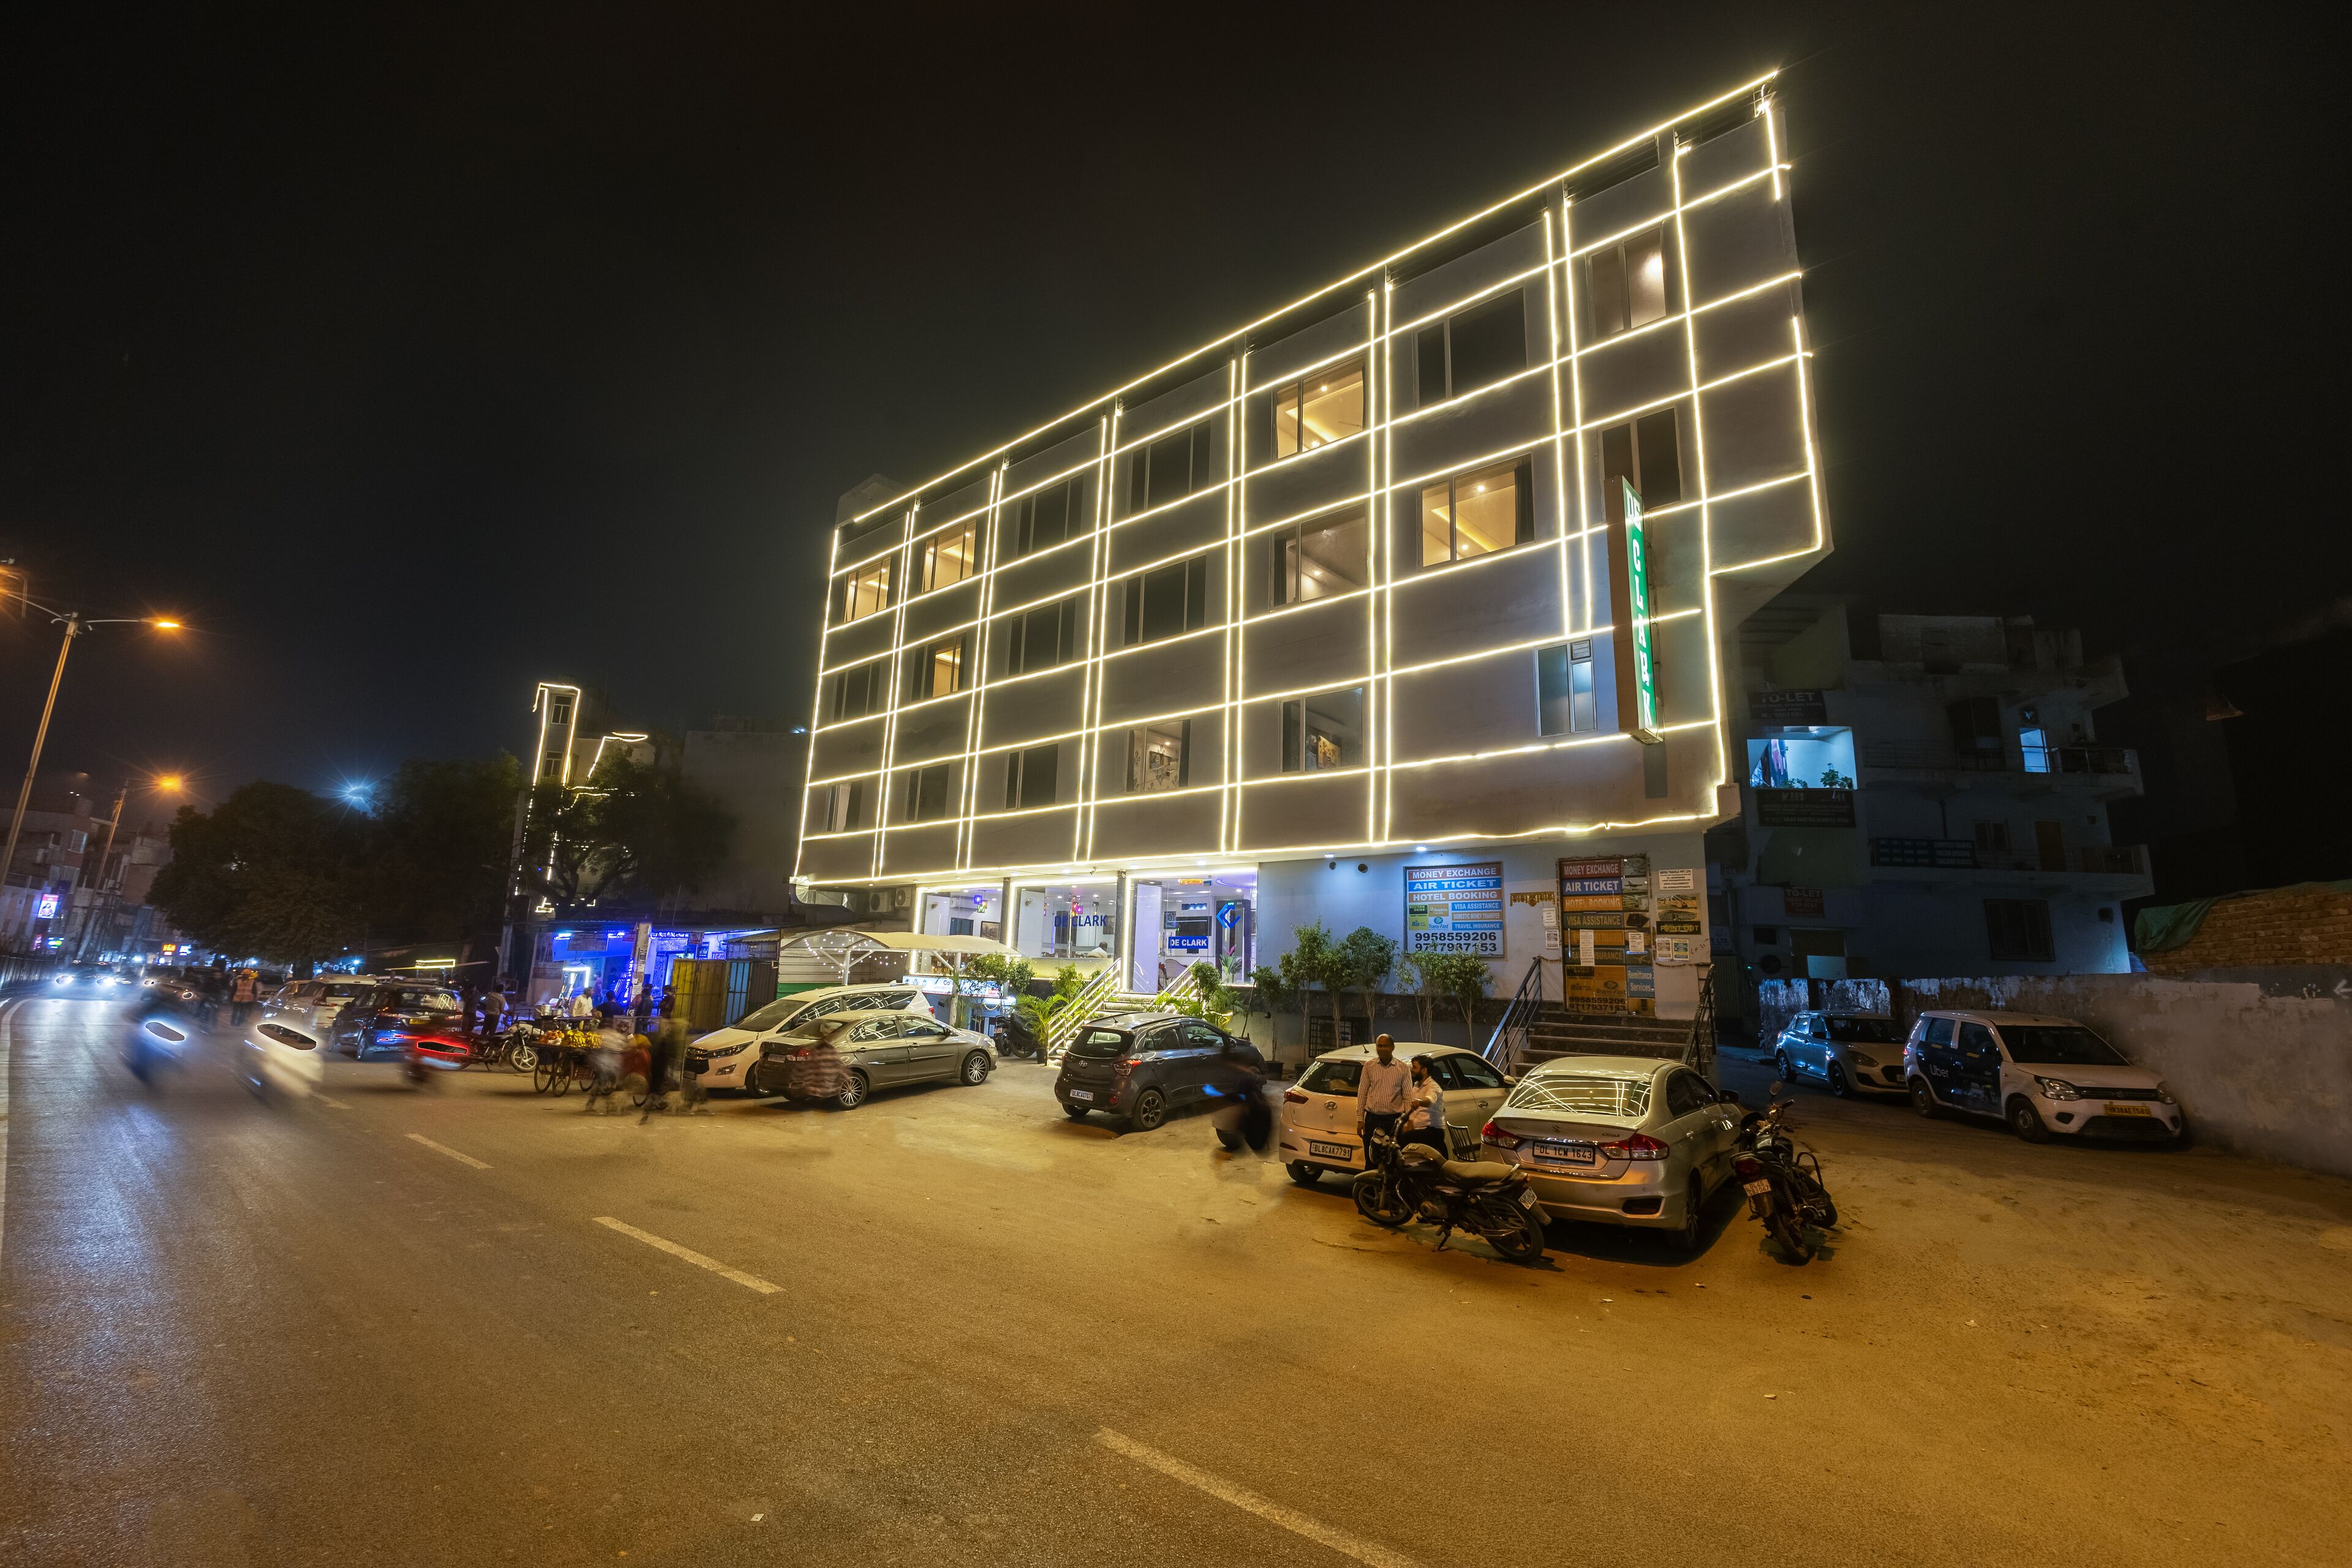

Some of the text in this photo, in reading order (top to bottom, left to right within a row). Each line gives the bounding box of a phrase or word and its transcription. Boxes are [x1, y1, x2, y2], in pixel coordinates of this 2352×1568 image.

[1626, 488, 1653, 728] DE CLARK
[1412, 868, 1496, 879] MONEY EXCHANGE
[1564, 863, 1619, 875] MONEY EXCHANGE
[1441, 880, 1496, 888] TICKET
[1565, 881, 1619, 892] AIR TICKET
[1449, 891, 1498, 900] BOOKING
[1565, 898, 1620, 909] HOTEL BOOKING
[1054, 914, 1107, 927] DE CLARK
[1567, 916, 1581, 925] VISA
[1582, 915, 1620, 925] ASSISTANCE
[1415, 932, 1497, 941] 9958559206
[1594, 951, 1622, 960] SURANCE
[1627, 970, 1652, 979] Remittance
[1630, 982, 1651, 992] Services
[1569, 1003, 1626, 1011] 9717937153
[1929, 1064, 1949, 1078] Uber
[1539, 1144, 1550, 1155] DL
[1572, 1148, 1592, 1159] 1643
